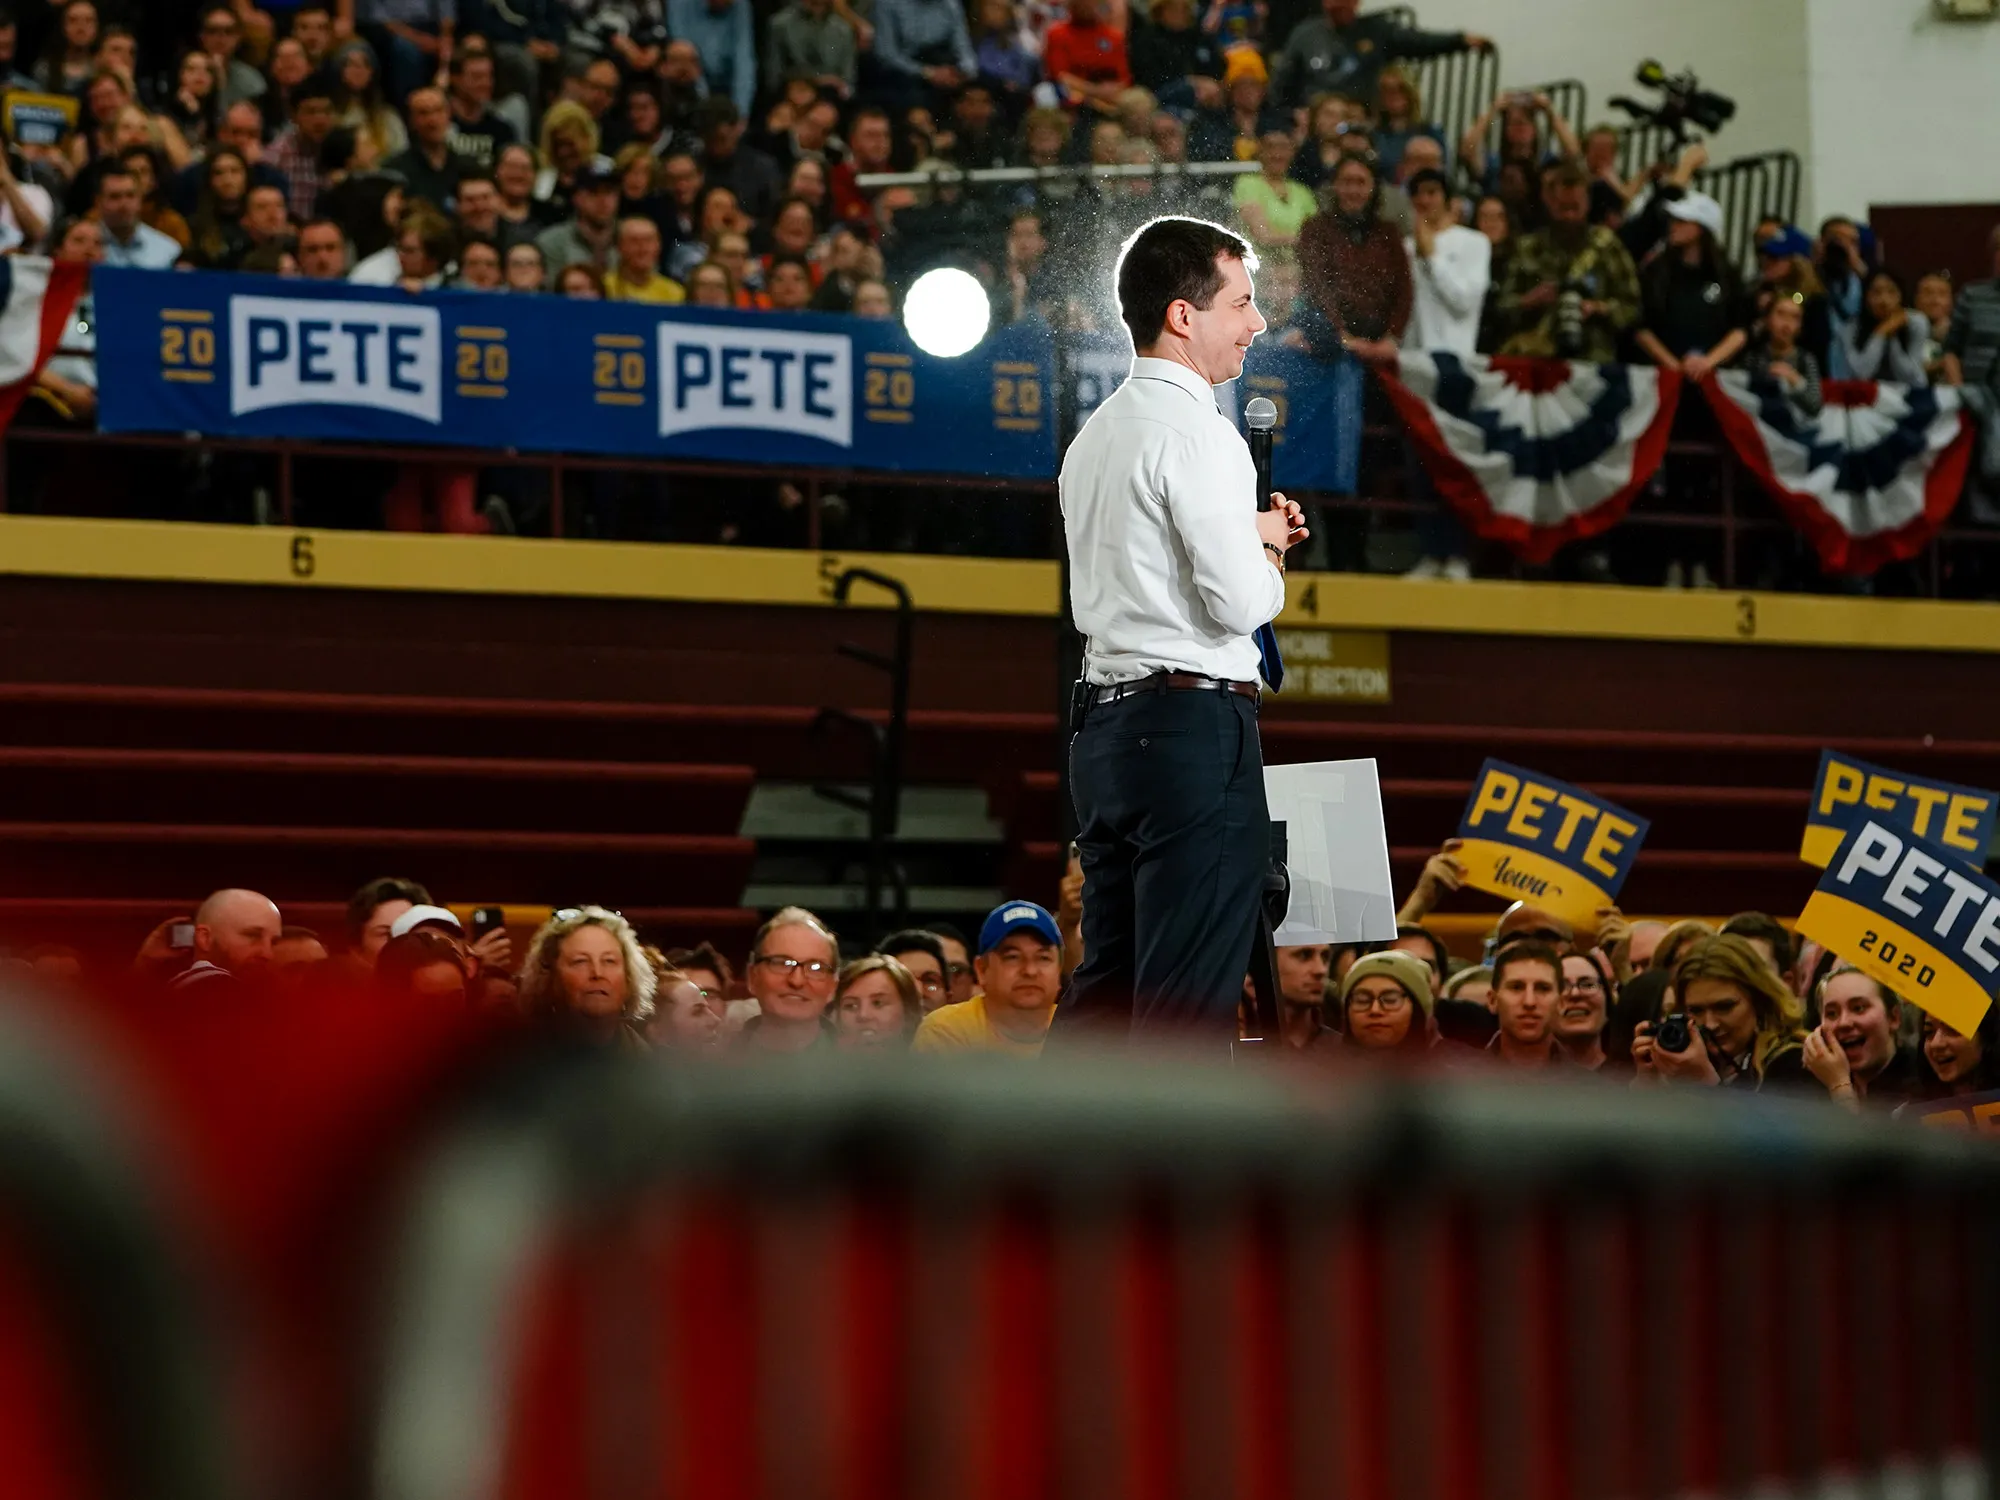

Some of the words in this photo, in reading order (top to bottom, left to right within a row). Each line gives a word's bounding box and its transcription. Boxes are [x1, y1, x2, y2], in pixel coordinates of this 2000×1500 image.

[160, 326, 215, 366] 20
[248, 316, 424, 395] PETE
[456, 343, 509, 381] 20
[593, 351, 646, 389] 20
[674, 343, 835, 420] PETE
[865, 369, 915, 408] 20
[993, 377, 1042, 416] 20
[291, 534, 315, 578] 6
[1298, 578, 1318, 618] 4
[1736, 596, 1756, 638] 3
[1310, 665, 1389, 696] SECTION
[1467, 768, 1639, 880] PETE
[1817, 759, 1990, 852] PETE
[1493, 855, 1563, 898] Iowa
[1836, 820, 2000, 974] PETE
[1859, 929, 1937, 988] 2020
